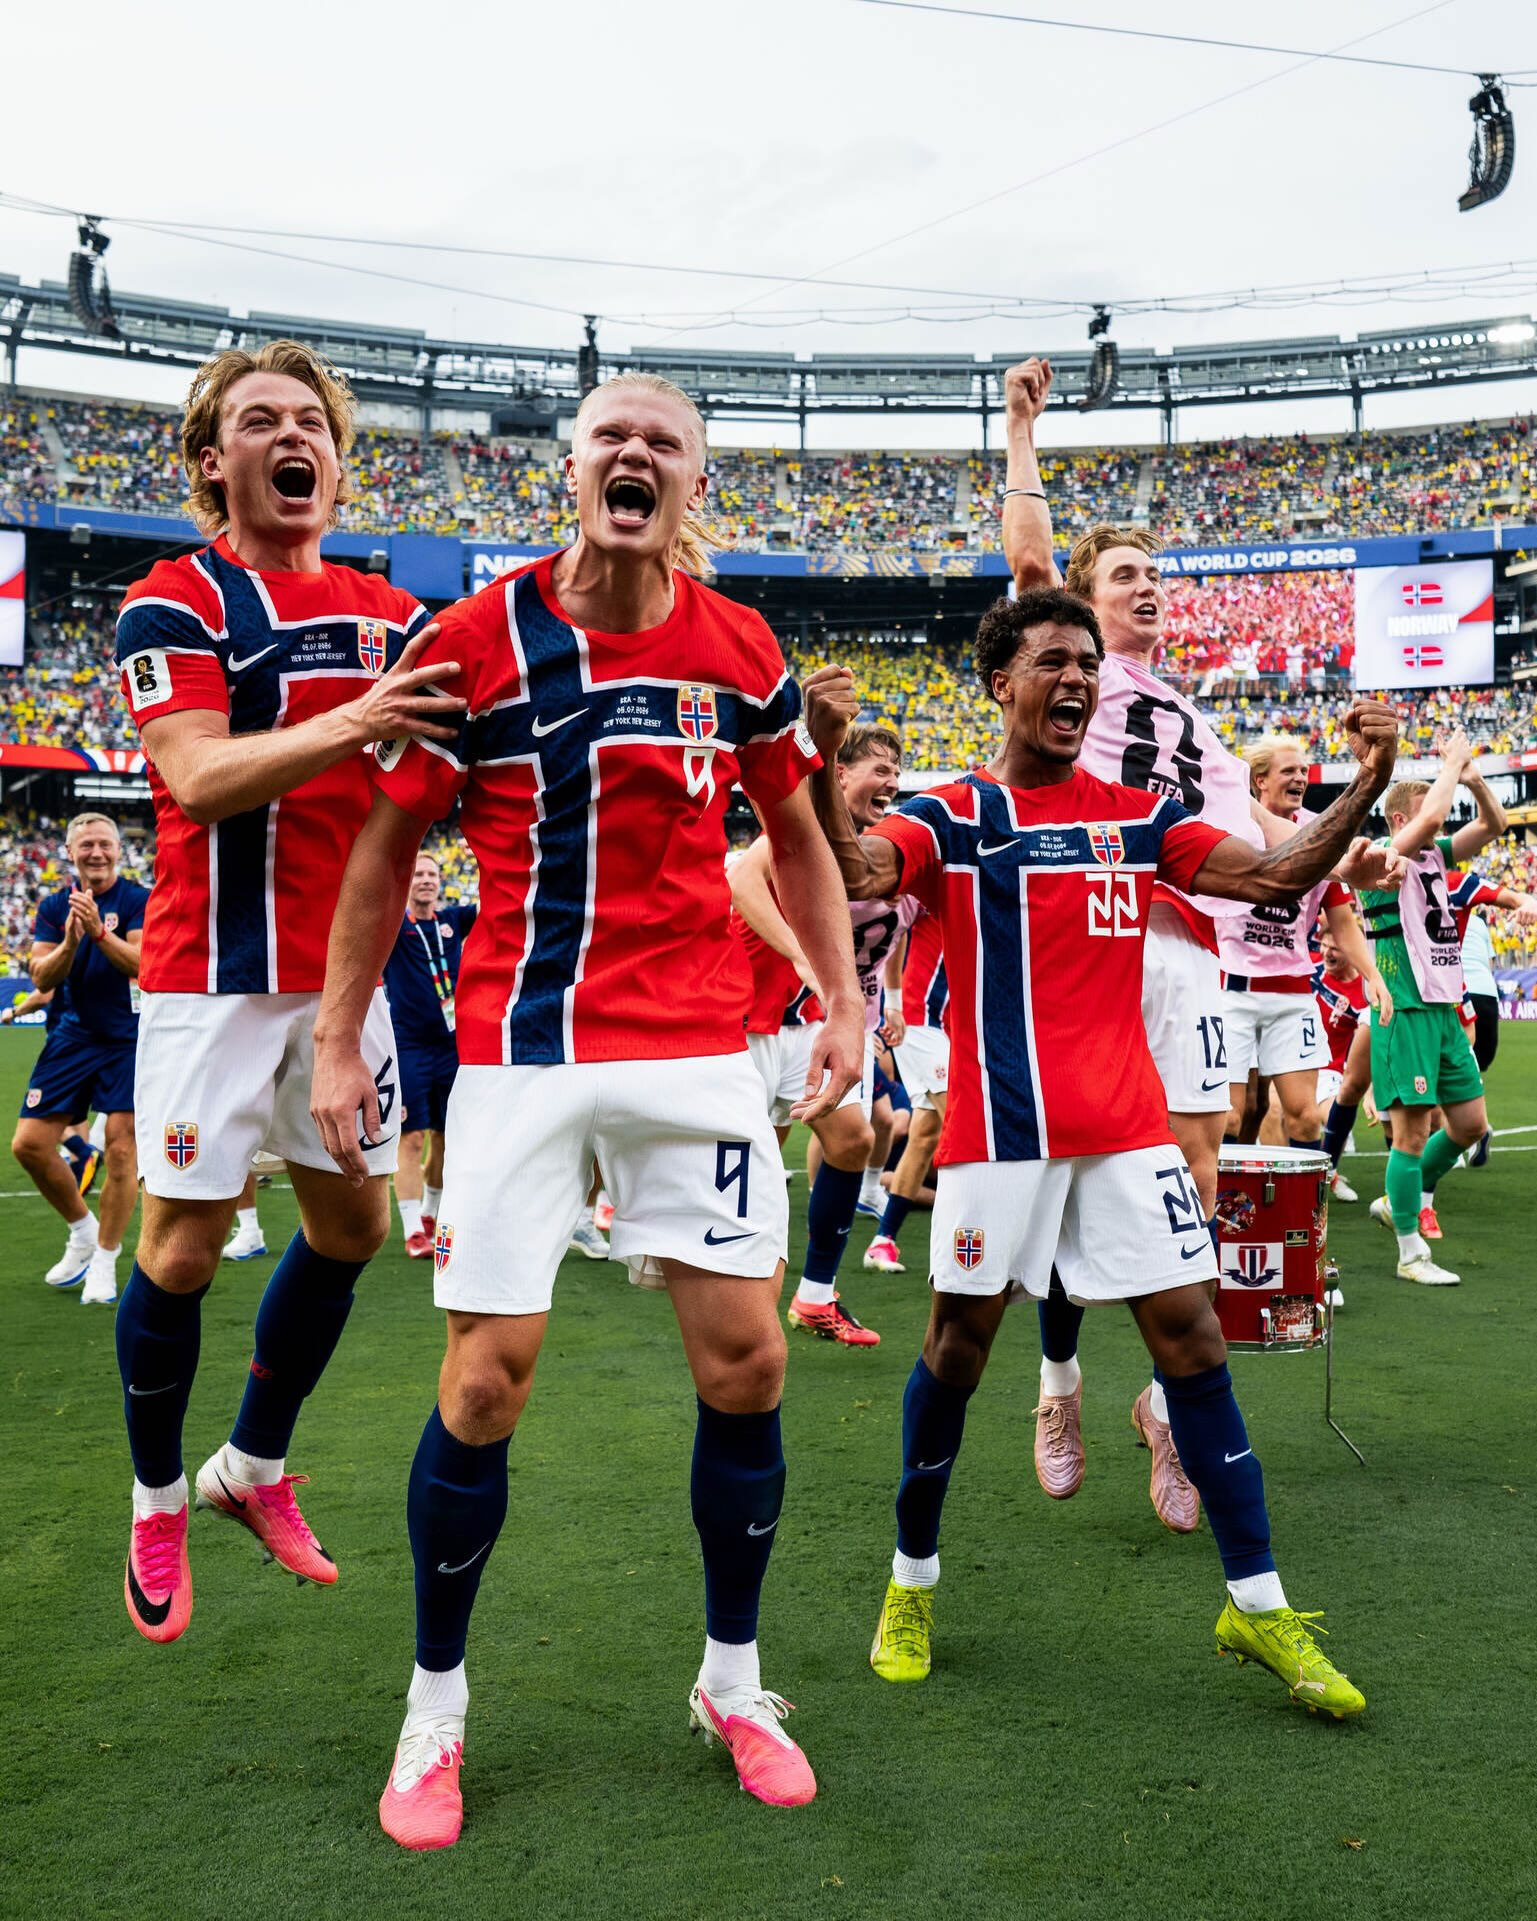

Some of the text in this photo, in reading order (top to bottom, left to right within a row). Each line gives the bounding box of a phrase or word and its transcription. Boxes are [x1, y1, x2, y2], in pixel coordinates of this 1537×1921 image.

[474, 553, 540, 576] NE
[1152, 547, 1357, 573] FA WORLD CUP 2026
[1387, 612, 1459, 637] NORWAY
[290, 652, 346, 662] NEW YORK NEW JERSEY
[603, 717, 662, 728] NEW YORK NEW JERSEY
[683, 746, 717, 818] 9
[1147, 778, 1185, 804] FIFA
[1085, 872, 1141, 938] 22
[1264, 906, 1290, 918] FIFA
[1243, 930, 1295, 950] 2026
[1246, 921, 1297, 937] WORLD CUP
[1437, 929, 1458, 938] FIFA
[1431, 955, 1462, 966] 202
[1515, 1000, 1537, 1019] AIR
[1196, 1016, 1228, 1069] 18
[1302, 1017, 1316, 1047] 2
[714, 1140, 751, 1218] 9
